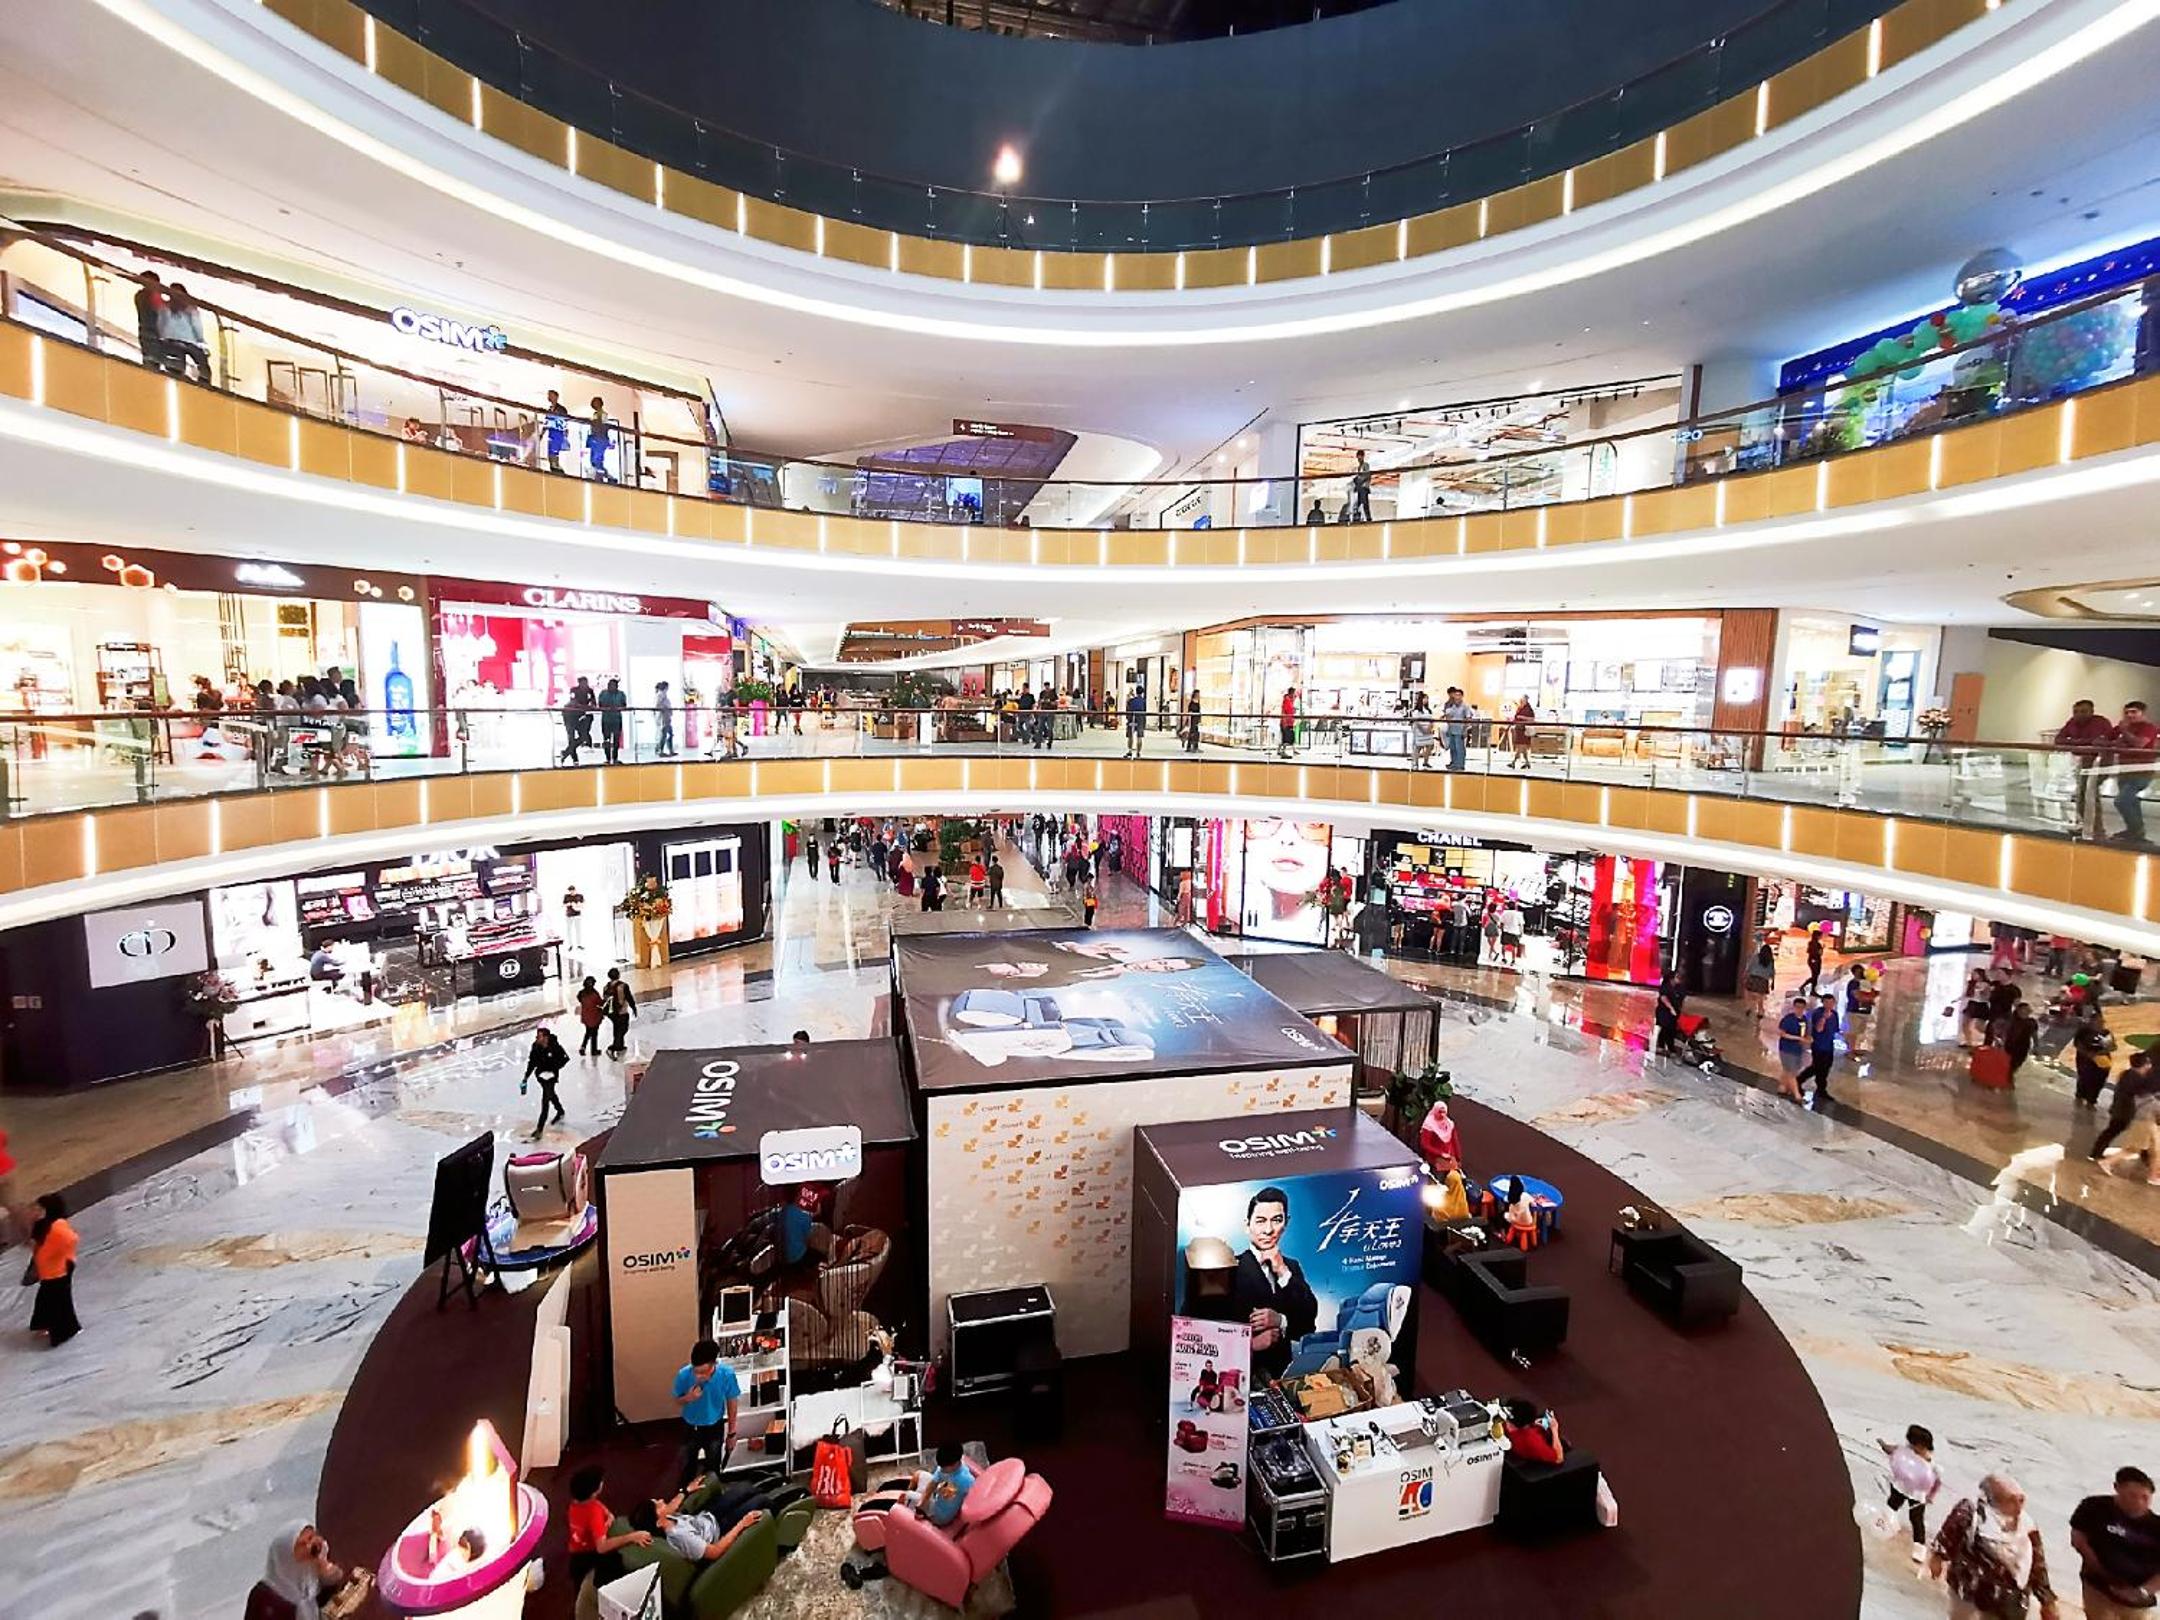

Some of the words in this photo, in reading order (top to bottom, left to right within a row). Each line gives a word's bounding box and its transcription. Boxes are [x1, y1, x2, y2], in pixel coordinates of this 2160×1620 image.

[391, 306, 483, 353] OSIM
[523, 587, 640, 613] CLARINS
[1417, 832, 1482, 847] CHANEL
[685, 1060, 740, 1122] OSIM
[1219, 1131, 1316, 1153] OSIM
[764, 1152, 836, 1173] OSIM
[623, 1251, 675, 1268] OSIM
[1467, 1454, 1493, 1465] OSIM
[1400, 1466, 1433, 1482] OSIM
